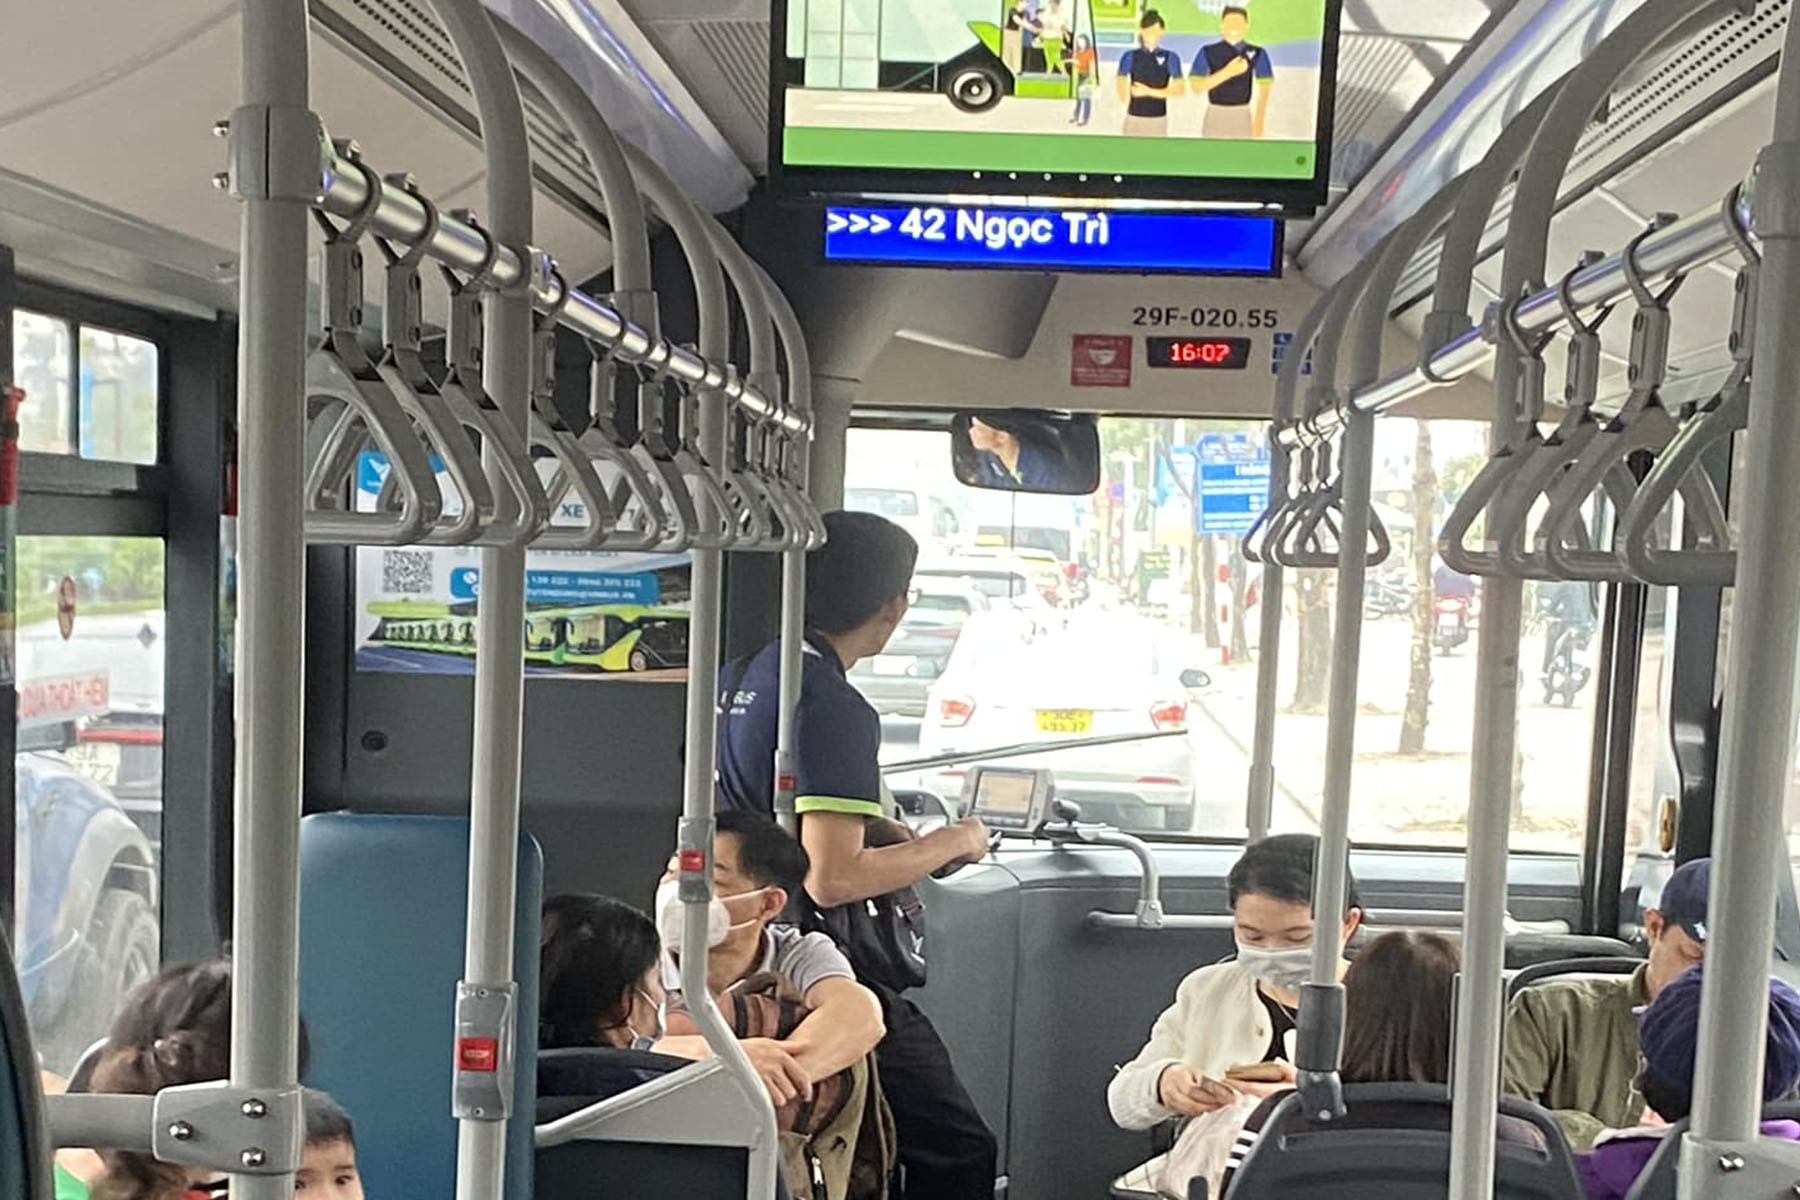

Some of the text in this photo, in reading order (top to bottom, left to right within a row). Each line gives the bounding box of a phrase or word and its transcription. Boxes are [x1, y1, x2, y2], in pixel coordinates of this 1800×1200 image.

[899, 207, 946, 240] 42
[956, 209, 1053, 249] Ngọc
[1133, 307, 1278, 328] 29F-020.55
[1170, 343, 1231, 362] 16:07
[561, 503, 585, 518] XE
